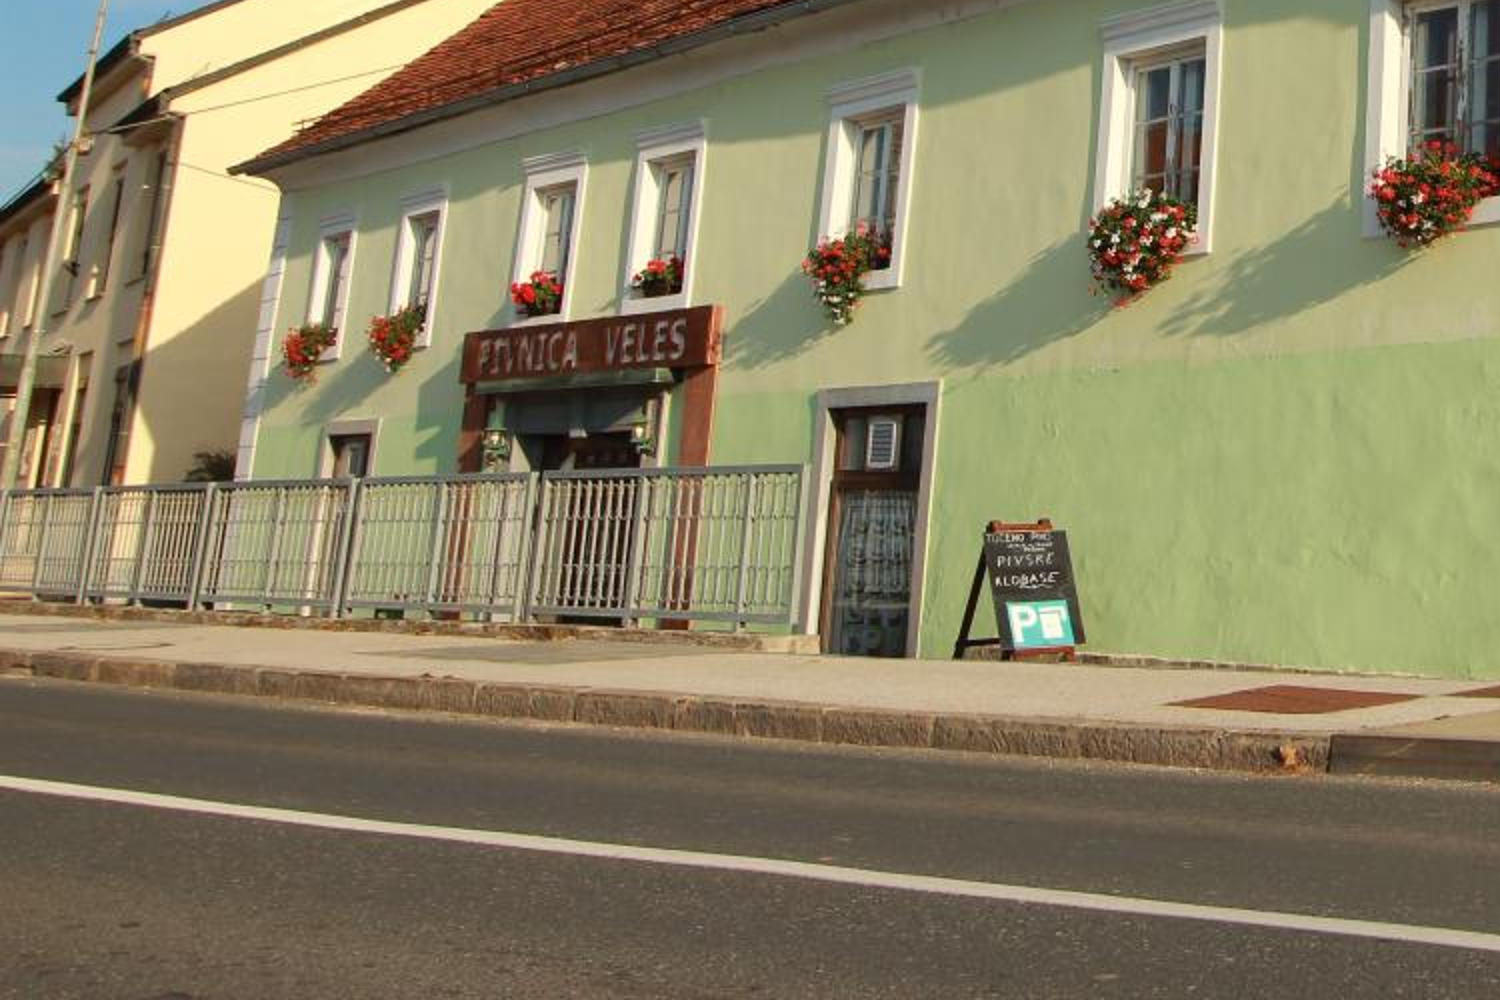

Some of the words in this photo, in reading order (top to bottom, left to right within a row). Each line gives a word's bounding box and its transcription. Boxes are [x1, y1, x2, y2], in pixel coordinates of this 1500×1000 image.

[478, 330, 576, 374] PIVNICA
[606, 318, 687, 366] VELES
[997, 552, 1055, 568] PIVSKE
